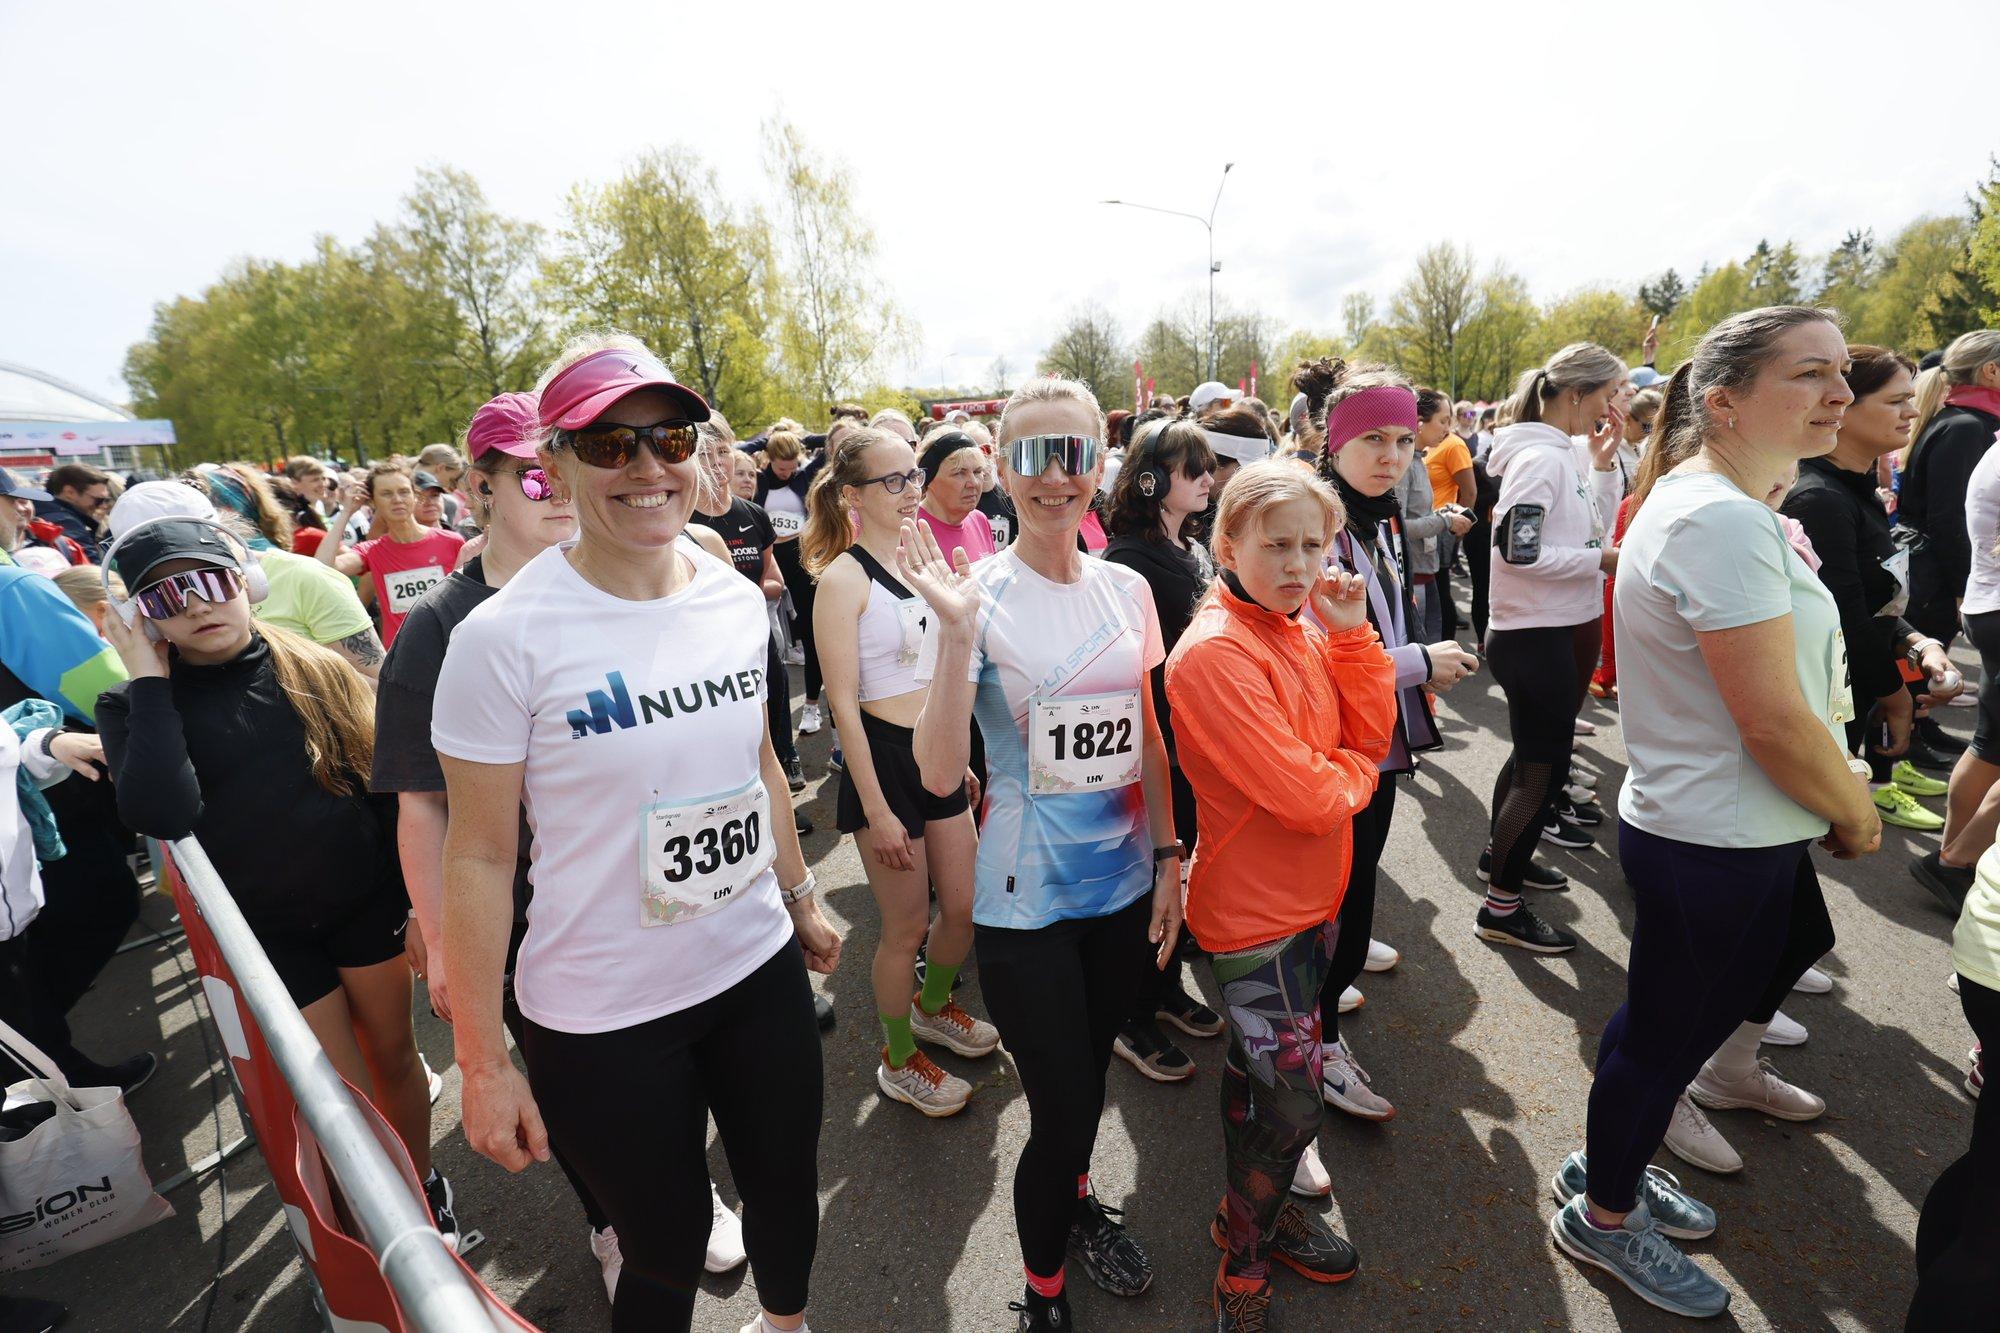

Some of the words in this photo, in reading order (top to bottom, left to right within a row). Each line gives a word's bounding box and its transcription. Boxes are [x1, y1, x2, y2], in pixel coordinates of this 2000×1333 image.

[771, 518, 798, 530] 4533
[1044, 665, 1068, 688] LA
[1048, 717, 1132, 761] 1822
[1086, 774, 1104, 784] LHV
[665, 820, 672, 828] A
[663, 811, 760, 883] 3360
[713, 885, 733, 900] LHV
[44, 1206, 84, 1230] WOMEN
